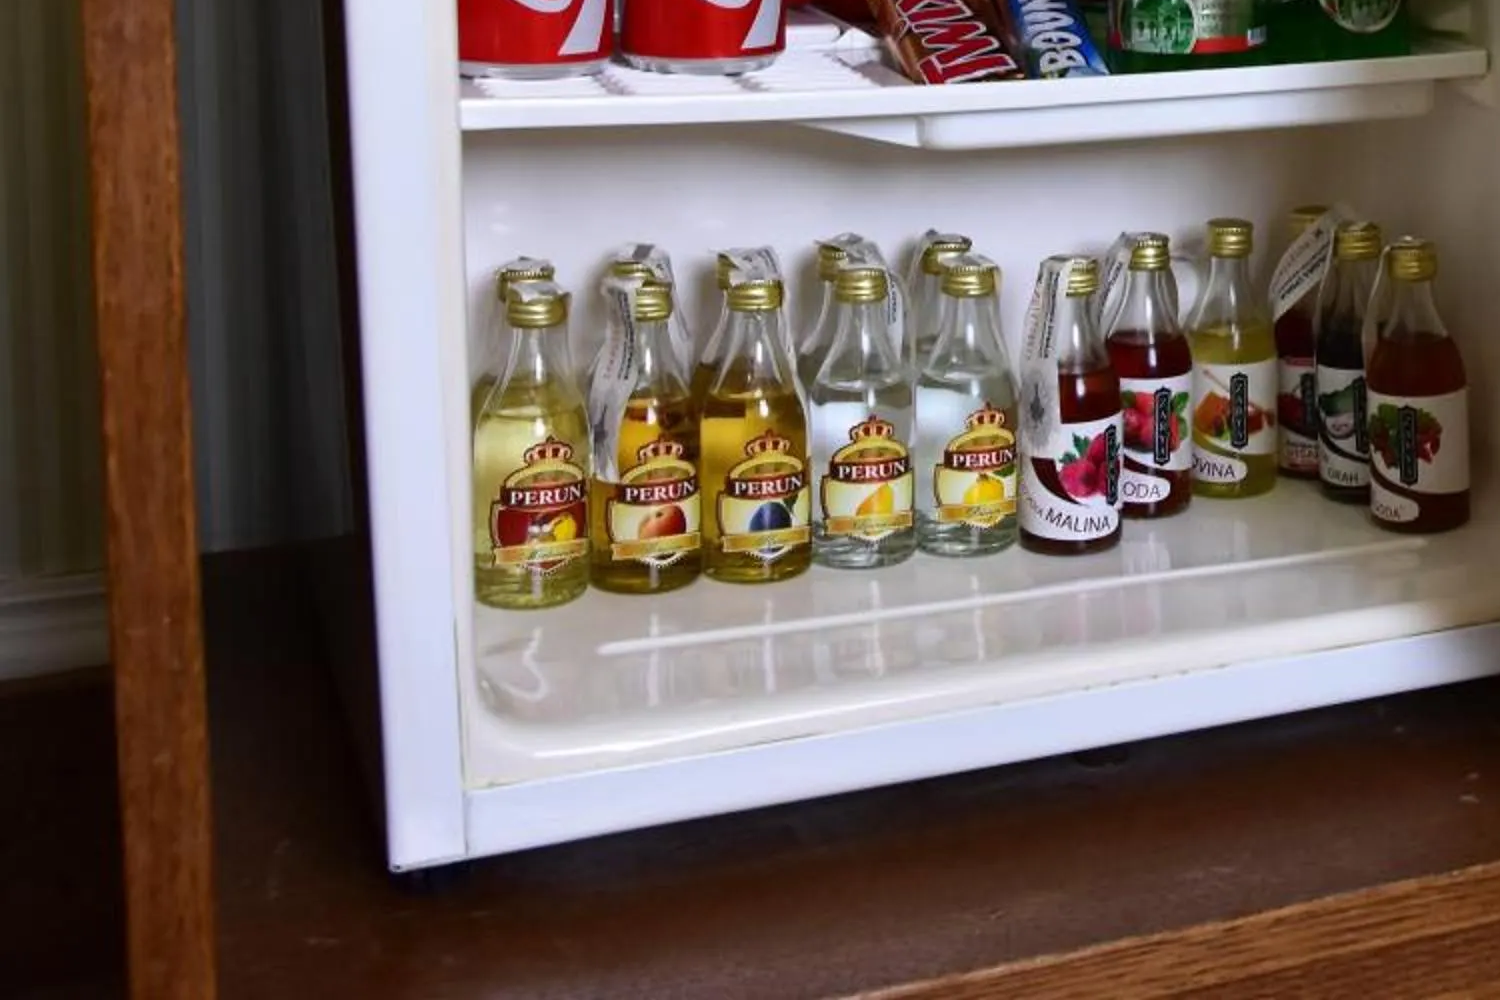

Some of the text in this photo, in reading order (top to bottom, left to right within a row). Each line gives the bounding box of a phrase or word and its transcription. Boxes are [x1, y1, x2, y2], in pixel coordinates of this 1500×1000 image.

[838, 459, 906, 480] PERUN
[952, 449, 1015, 469] PERUN
[511, 482, 582, 506] PERUN
[626, 479, 695, 502] PERUN
[735, 476, 804, 497] PERUN
[1046, 505, 1112, 534] MALINA
